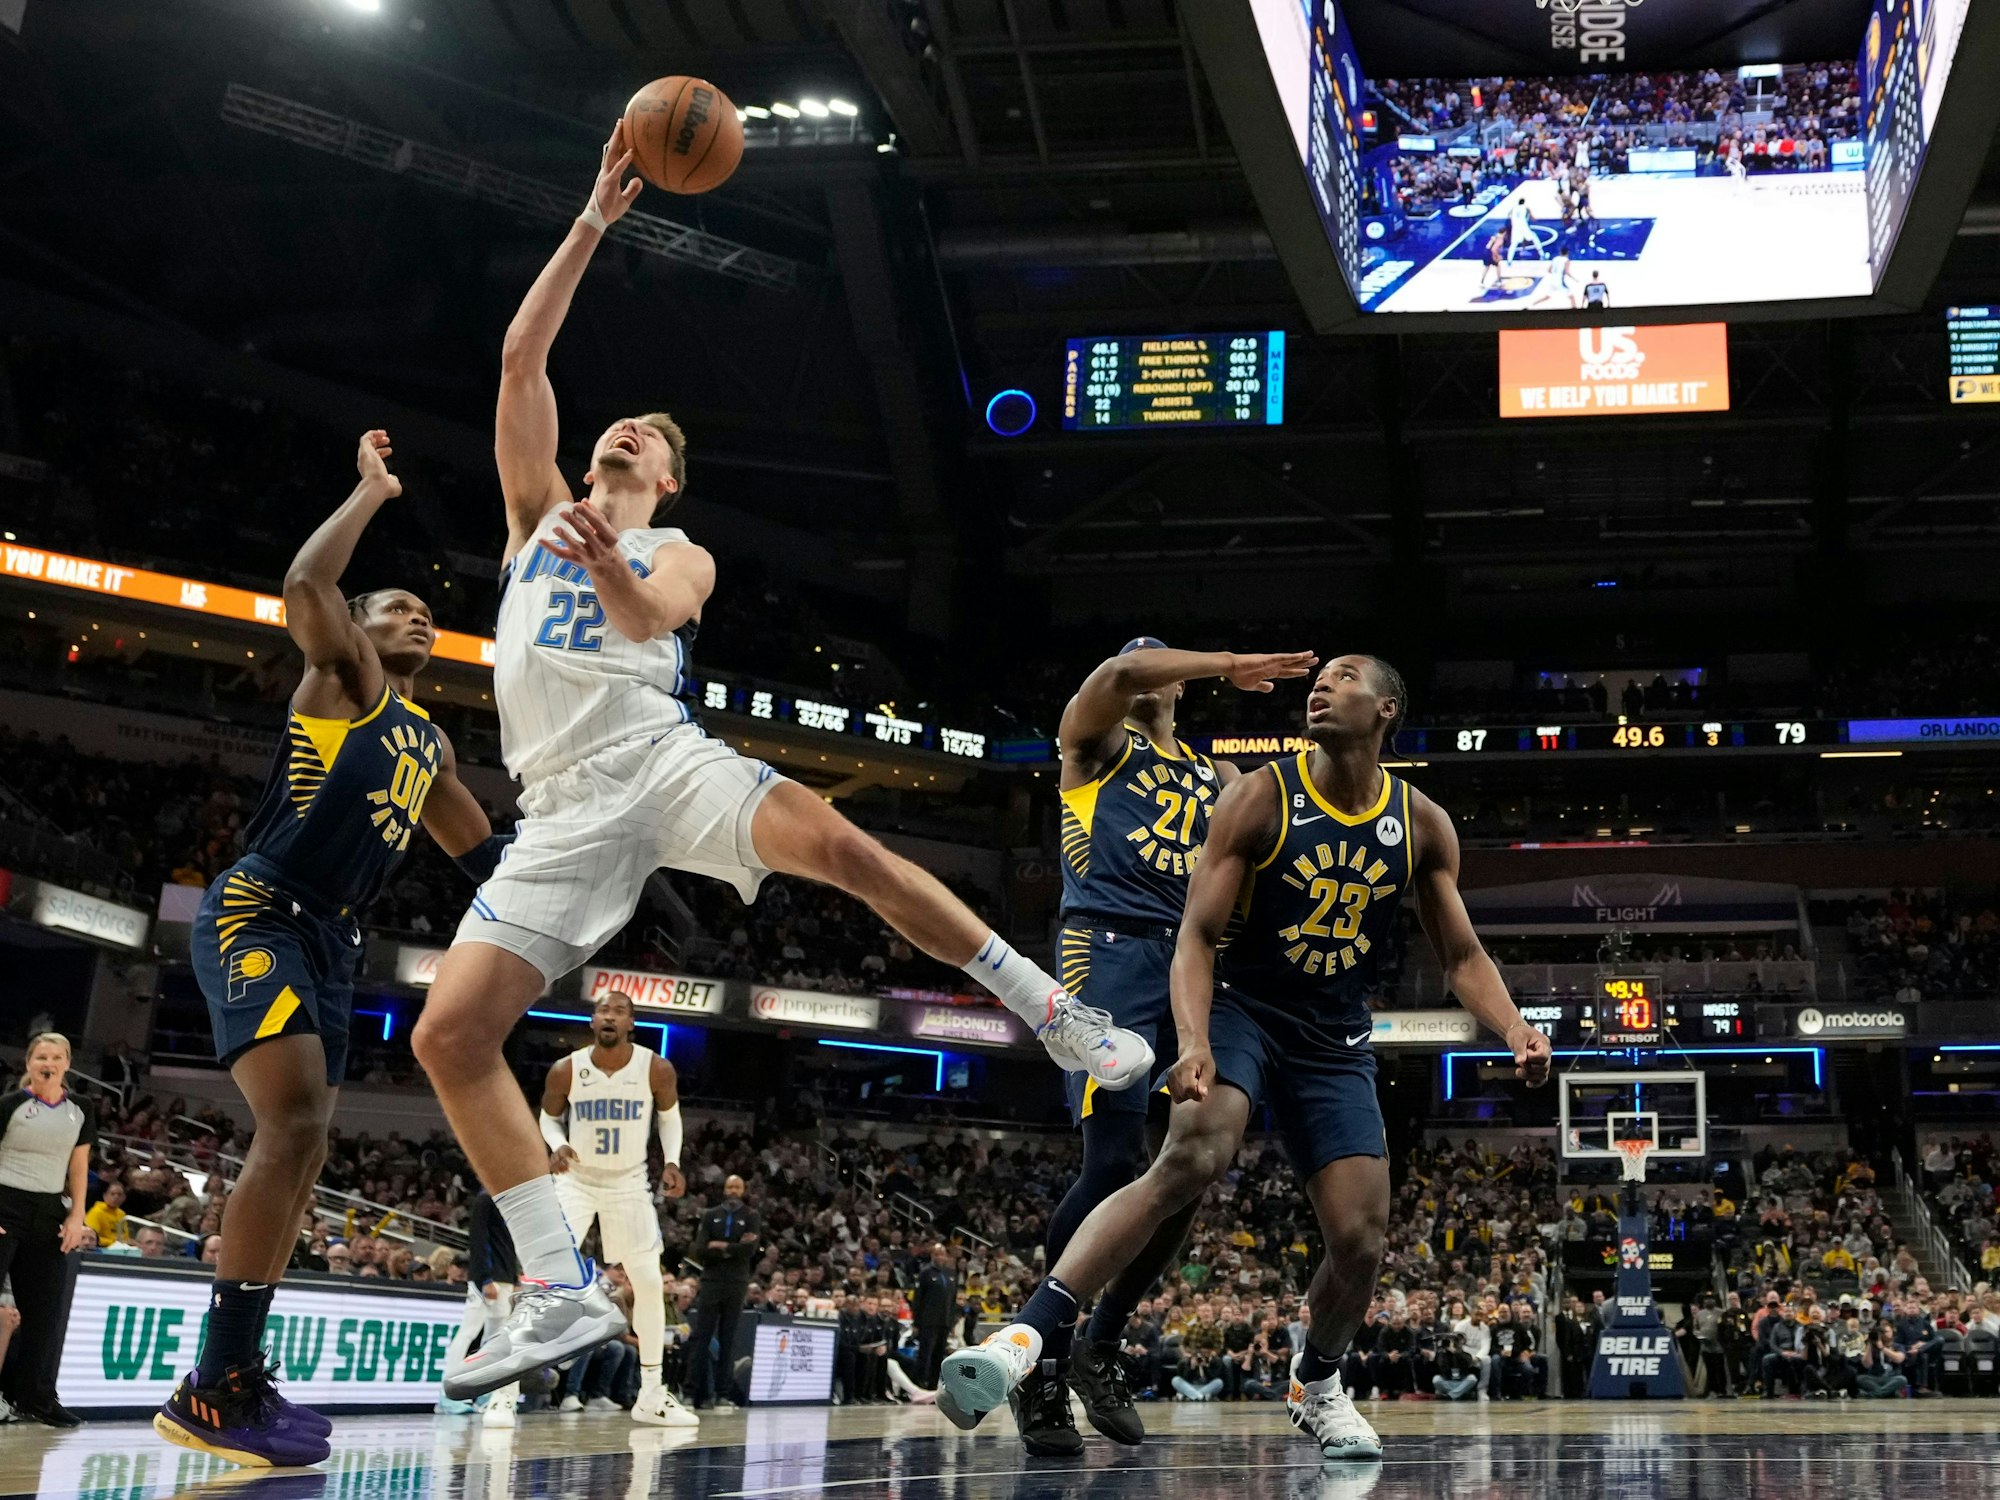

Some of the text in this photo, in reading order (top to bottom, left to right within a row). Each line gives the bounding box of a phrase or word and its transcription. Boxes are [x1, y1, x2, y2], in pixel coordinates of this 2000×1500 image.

[674, 86, 713, 155] Wilson
[1092, 342, 1119, 355] 48.5
[1142, 342, 1169, 352] FIELD
[1171, 341, 1197, 351] GOAL
[1230, 338, 1257, 350] 42.9
[1091, 356, 1118, 368] 61.5
[1139, 355, 1163, 366] FREE
[1165, 354, 1200, 365] THROW
[1229, 352, 1257, 364] 60.0
[1090, 370, 1118, 382] 41.7
[1141, 369, 1181, 380] 3-POINT
[1183, 368, 1196, 379] FG
[1229, 366, 1256, 378] 35.7
[1271, 351, 1281, 404] MAGIC
[1580, 363, 1642, 380] FOODS
[1065, 350, 1079, 418] PACERS
[1086, 384, 1103, 396] 35
[1133, 381, 1213, 394] REBOUNDS (OFF)
[1225, 380, 1241, 392] 30
[1095, 398, 1111, 410] 22
[1151, 396, 1193, 408] ASSISTS
[1235, 394, 1250, 406] 13
[1520, 387, 1546, 409] WE
[1549, 386, 1593, 408] HELP
[1594, 384, 1628, 407] YOU
[1631, 383, 1679, 405] MAKE
[1095, 412, 1110, 424] 14
[1143, 410, 1201, 421] TURNOVERS
[1234, 408, 1250, 420] 10
[5, 547, 44, 577] YOU
[46, 556, 102, 588] MAKE
[254, 597, 282, 622] WE
[534, 591, 606, 652] 22
[704, 692, 727, 710] 35
[795, 699, 850, 719] FIELD GOALS
[750, 702, 773, 719] 22
[798, 710, 845, 733] 32/66
[865, 712, 923, 734] FREE THROWS
[1702, 722, 1722, 733] QTR
[875, 725, 912, 745] 8/13
[1536, 726, 1561, 736] SHOT
[1612, 726, 1665, 748] 49.6
[1775, 722, 1806, 744] 79
[1920, 722, 2000, 738] ORLANDO
[1212, 738, 1281, 754] INDIANA
[1457, 729, 1487, 751] 87
[1540, 735, 1558, 750] 11
[1707, 732, 1719, 746] 3
[942, 736, 985, 759] 15/36
[390, 751, 433, 825] 00
[1294, 794, 1305, 808] 6
[1152, 789, 1198, 846] 21
[1282, 840, 1396, 901] INDIANA
[47, 895, 136, 937] salesforce
[1300, 877, 1371, 939] 23
[1596, 907, 1657, 921] FLIGHT
[1278, 924, 1371, 976] PACERS
[591, 971, 715, 1008] POINTSBET
[1605, 981, 1643, 999] 49.4
[1520, 1006, 1562, 1020] PACERS
[1583, 1005, 1592, 1017] 3
[1621, 998, 1651, 1029] 10
[1703, 1003, 1739, 1016] MAGIC
[952, 1017, 1007, 1032] DONUTS
[1400, 1018, 1471, 1033] Kinetico
[1712, 1020, 1730, 1033] 79
[1825, 1011, 1905, 1027] motorola
[1618, 1034, 1659, 1043] TISSOT
[575, 1098, 644, 1122] MAGIC
[595, 1128, 620, 1155] 31
[1617, 1296, 1651, 1306] BELLE
[1621, 1307, 1647, 1316] TIRE
[100, 1304, 186, 1380] WE
[333, 1318, 461, 1383] SOYBE
[1600, 1336, 1671, 1355] BELLE
[1607, 1358, 1661, 1375] TIRE
